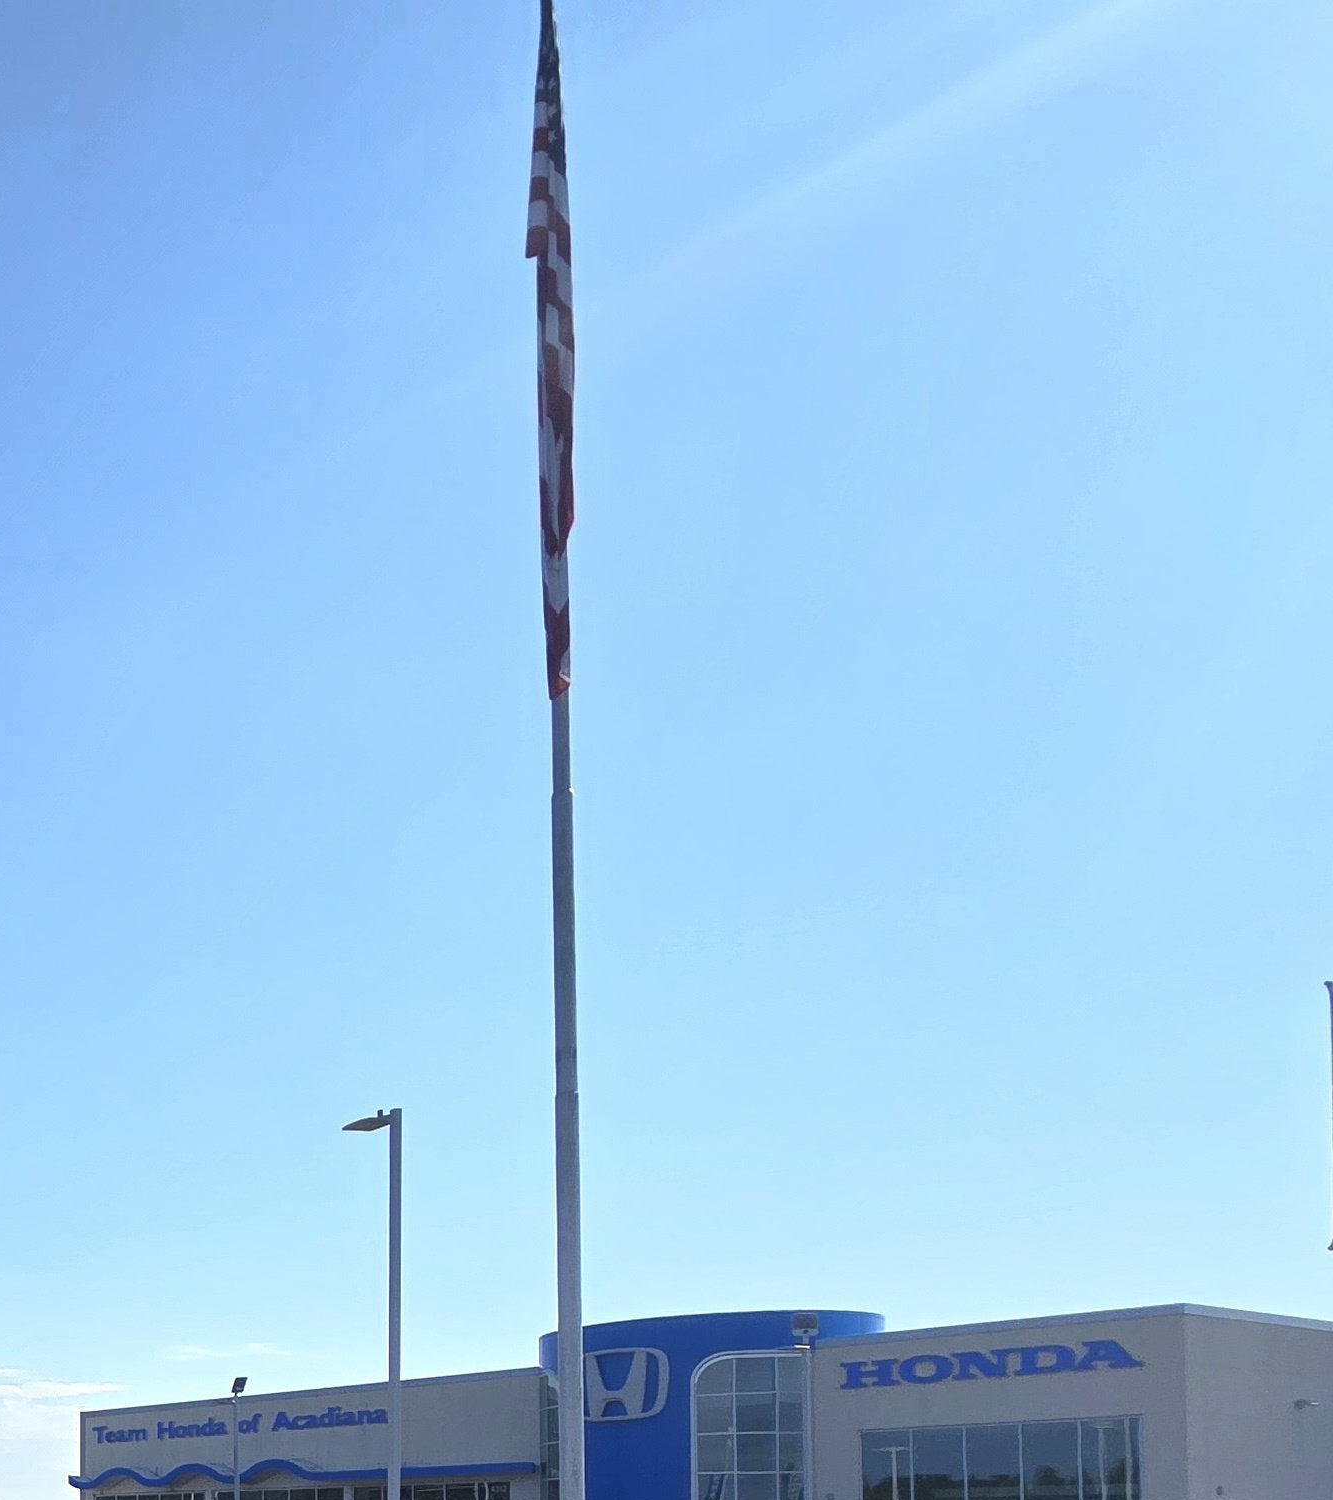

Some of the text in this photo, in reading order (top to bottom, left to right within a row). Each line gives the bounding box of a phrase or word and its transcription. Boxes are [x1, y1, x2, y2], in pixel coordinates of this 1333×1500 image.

[839, 1339, 1145, 1390] HONDA
[91, 1406, 389, 1444] Team Honda of Acadiana
